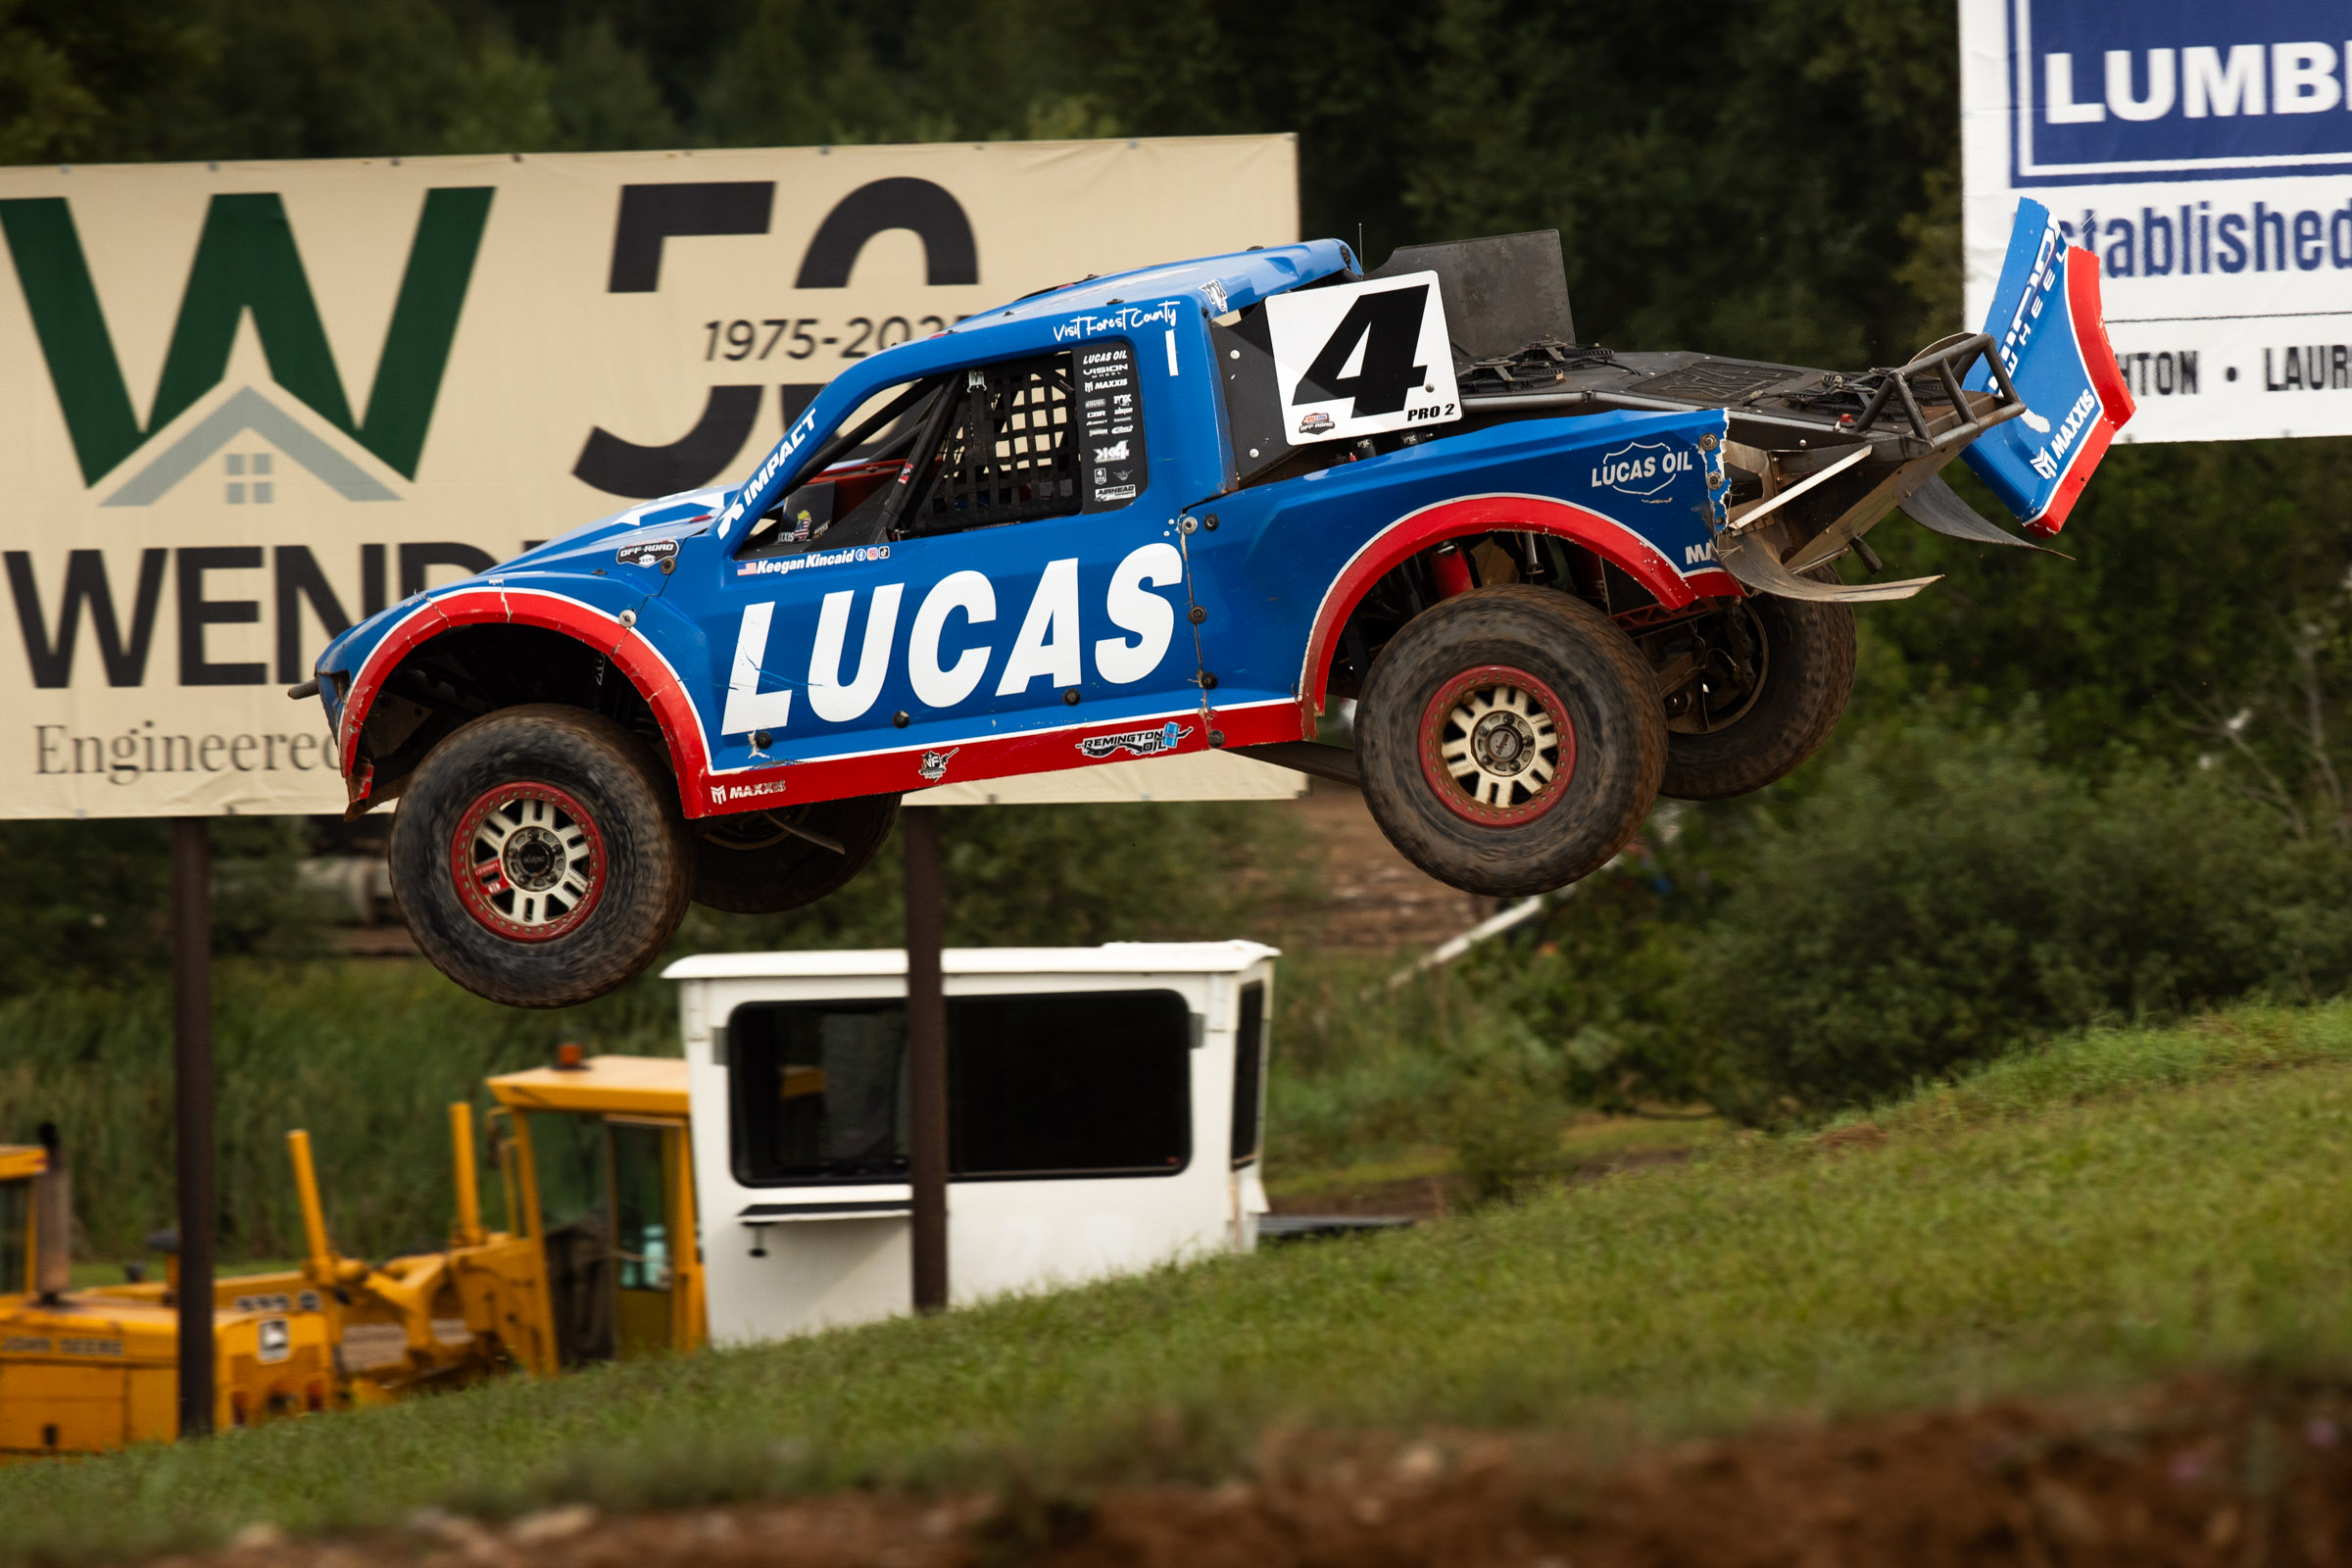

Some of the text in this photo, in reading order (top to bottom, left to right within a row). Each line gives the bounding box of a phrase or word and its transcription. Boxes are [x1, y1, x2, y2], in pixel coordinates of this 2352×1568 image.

[2044, 40, 2352, 123] LUMB
[1054, 300, 1181, 342] Visit Forest County
[2006, 247, 2068, 378] WHEEL
[703, 315, 973, 363] 1975-20
[1292, 283, 1430, 419] 4
[1083, 350, 1128, 366] LUCAS OIL
[1083, 364, 1128, 375] VISION
[1095, 378, 1128, 390] MAXXIS
[1113, 394, 1132, 407] FOX
[1407, 403, 1455, 421] PRO 2
[2050, 388, 2096, 460] MAXXIS
[743, 408, 816, 508] IMPACT
[1592, 451, 1693, 487] LUCAS OIL
[619, 543, 674, 558] OFF-ROAD
[757, 549, 857, 574] Keegan Kincaid
[721, 542, 1183, 735] LUCAS
[1083, 730, 1167, 753] REMINGTON OIL
